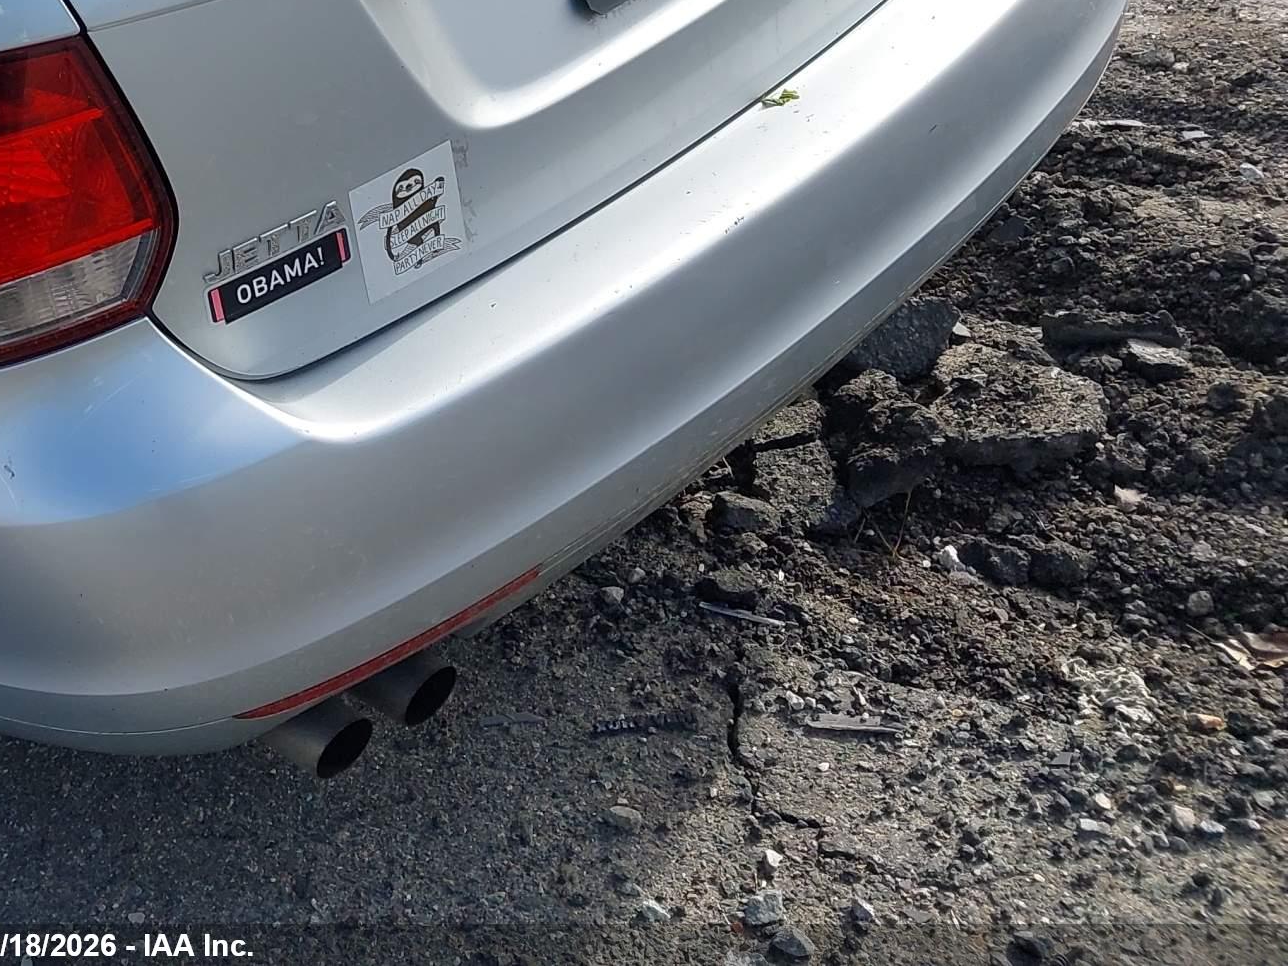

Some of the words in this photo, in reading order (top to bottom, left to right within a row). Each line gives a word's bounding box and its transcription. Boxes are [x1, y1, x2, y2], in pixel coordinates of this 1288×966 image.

[381, 210, 401, 227] NAP
[403, 198, 418, 217] ALL
[419, 184, 438, 203] DAY
[203, 201, 346, 283] JETTA
[390, 228, 409, 248] SLEEP
[410, 220, 423, 239] ALL
[422, 207, 444, 229] NIGHT
[236, 247, 325, 304] OBAMA!
[395, 252, 419, 274] PARTY
[417, 237, 443, 261] NEVER
